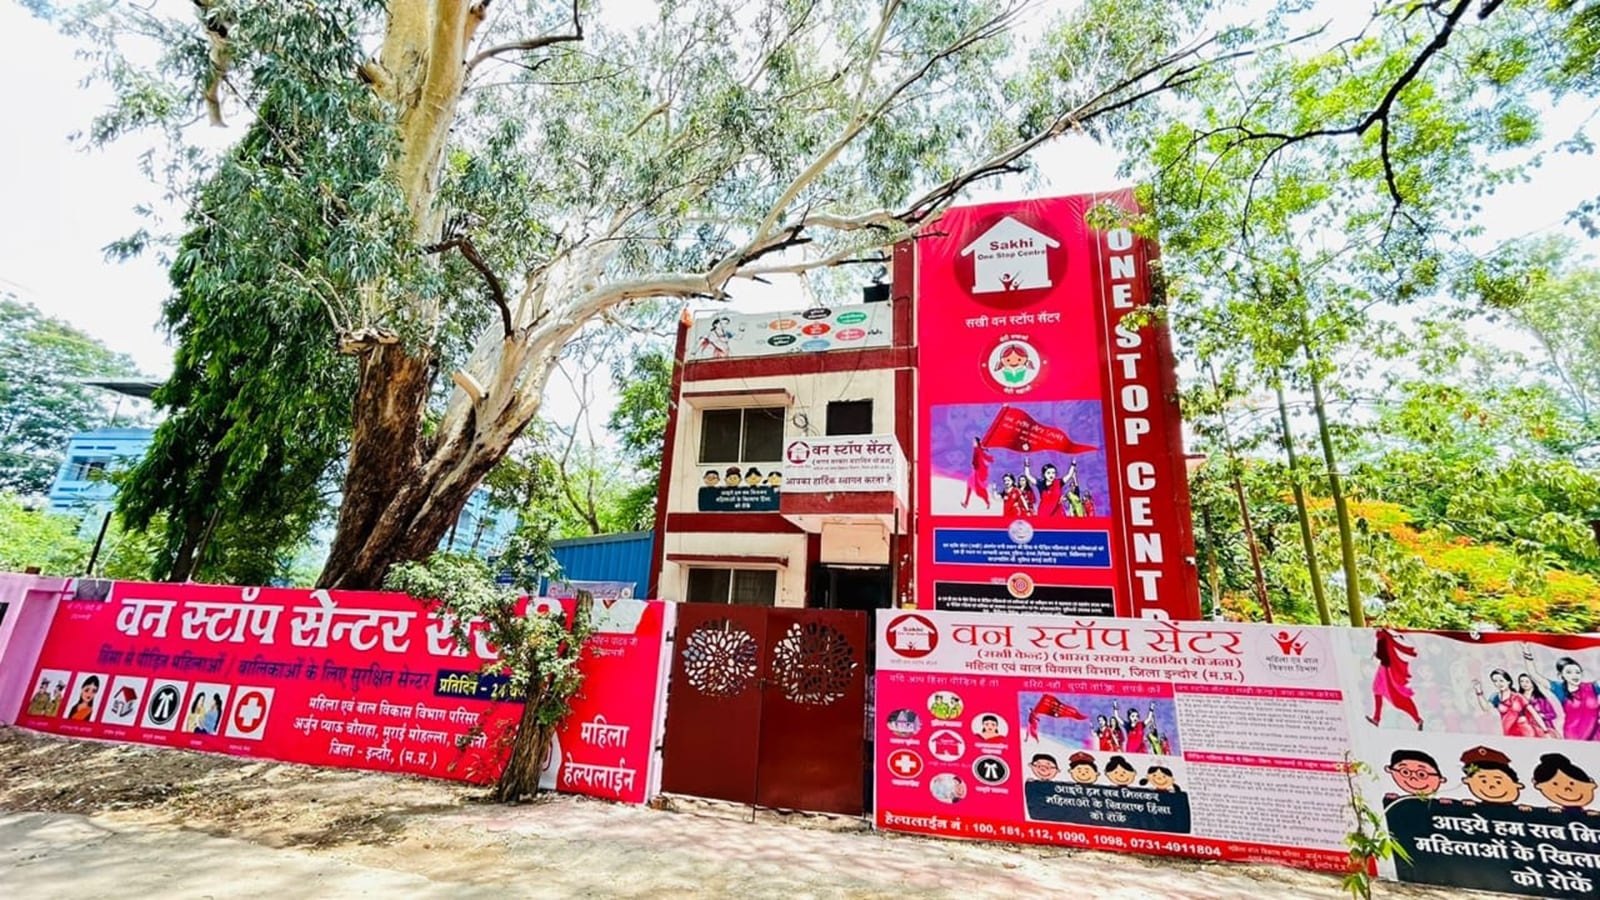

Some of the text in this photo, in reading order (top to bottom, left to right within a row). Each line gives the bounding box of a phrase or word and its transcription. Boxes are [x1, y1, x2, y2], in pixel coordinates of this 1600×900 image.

[990, 238, 1033, 250] Sakhi
[1107, 229, 1136, 308] ONE
[966, 315, 988, 328] सखी
[992, 316, 1006, 326] वन
[1010, 311, 1034, 325] स्टॉप
[1115, 323, 1150, 445] STOP
[812, 440, 892, 455] वन स्टॉप सेंटर
[116, 598, 177, 638] वन
[181, 587, 285, 645] स्टॉप
[290, 589, 417, 653] सेन्टर
[951, 620, 1243, 655] वन स्टॉप सेंटर
[965, 659, 998, 672] महिला
[1001, 662, 1016, 673] एवं
[1045, 662, 1083, 675] विकास
[1086, 664, 1125, 678] विभाग,
[1129, 667, 1160, 679] जिला
[1202, 668, 1245, 683] (म.प्र.)
[1053, 651, 1089, 663] (भारत
[1093, 653, 1135, 664] सरकार
[306, 657, 319, 680] के
[322, 659, 347, 688] लिए
[351, 662, 393, 692] सुरक्षित
[398, 664, 431, 690] सेन्टर
[438, 674, 478, 696] प्रतिदिन
[293, 714, 318, 736] अर्जुन
[309, 693, 340, 711] महिला
[341, 697, 354, 716] एवं
[379, 699, 412, 719] विकास
[415, 703, 446, 721] विभाग
[449, 706, 479, 726] परिसर
[581, 714, 630, 749] महिला
[329, 738, 354, 757] जिला
[564, 752, 636, 796] हेल्पलाईन
[1086, 788, 1100, 797] हम
[885, 810, 947, 830] हेल्पलाईन
[972, 823, 997, 835] 100,
[1000, 826, 1025, 838] 181,
[1029, 828, 1052, 840] 112,
[1057, 831, 1089, 844] 1090,
[1093, 835, 1127, 848] 1098,
[1130, 838, 1222, 856] 0731-4911804
[1432, 813, 1600, 844] आइये हम सब मि
[1413, 833, 1600, 868] महिलाओं के खिला
[1510, 867, 1593, 893] को रोकें
